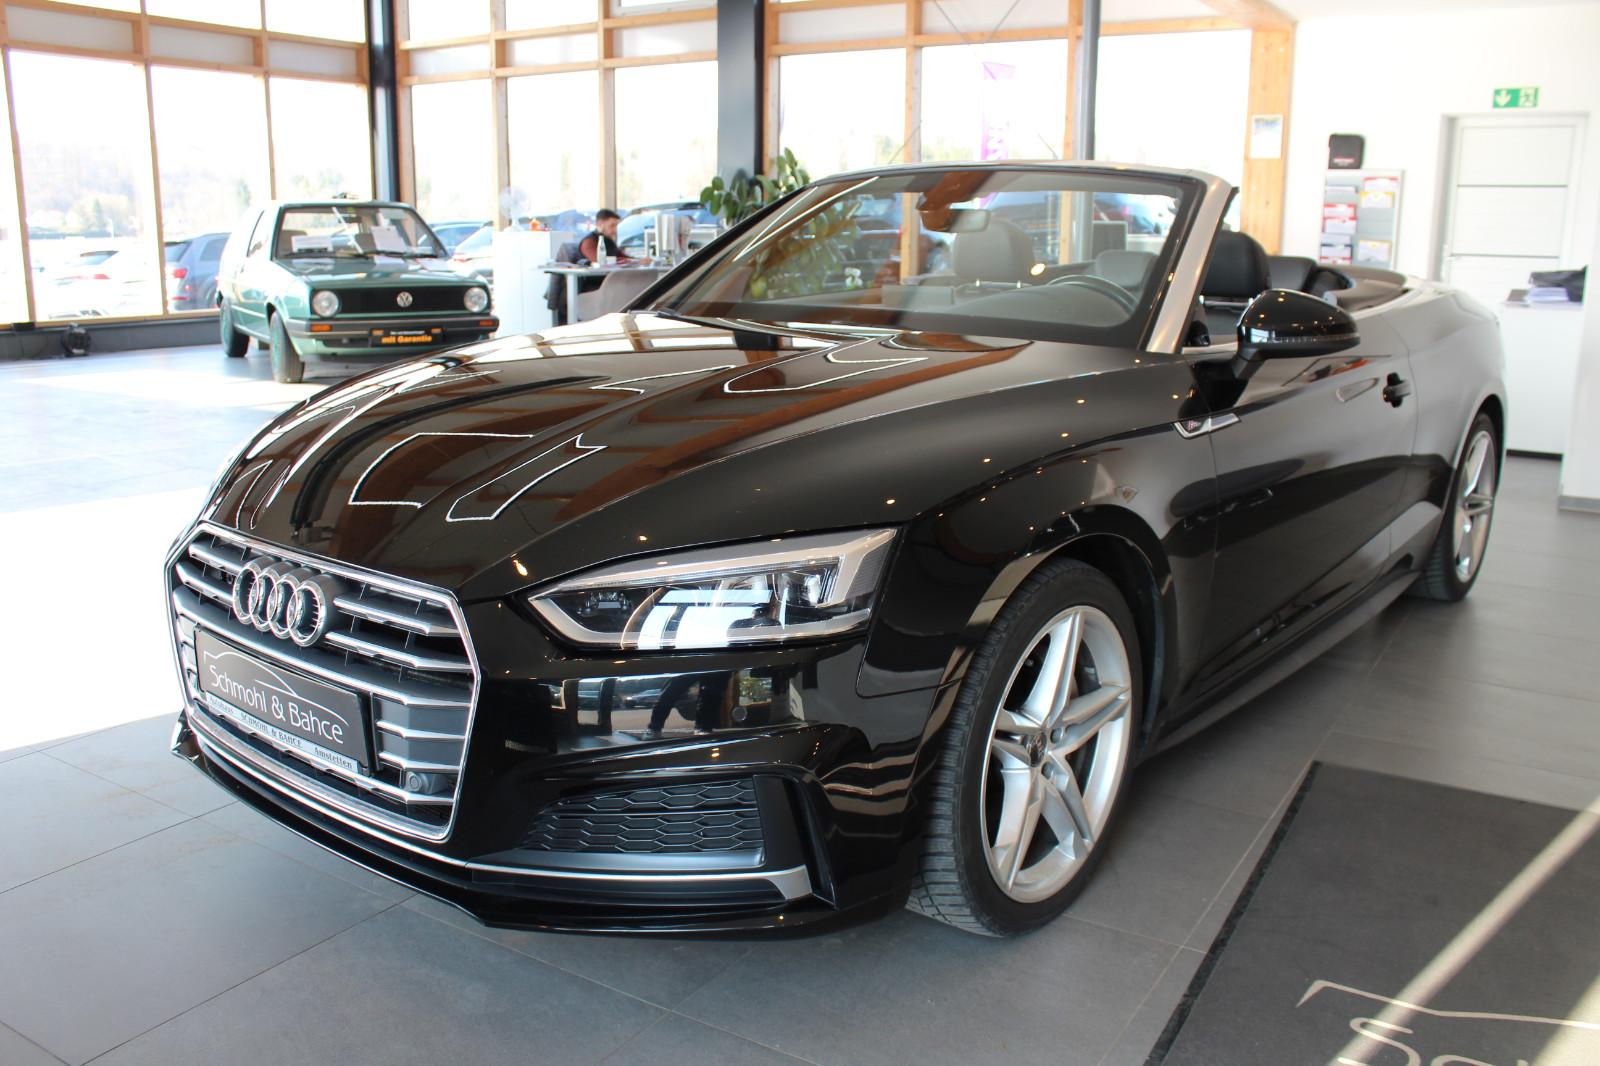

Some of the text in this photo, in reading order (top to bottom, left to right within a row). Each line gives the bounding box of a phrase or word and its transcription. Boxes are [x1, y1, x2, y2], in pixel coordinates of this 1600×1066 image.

[381, 334, 433, 345] mit Garantie
[209, 664, 344, 745] Schmohl & Bahce
[314, 747, 353, 769] Amstetten
